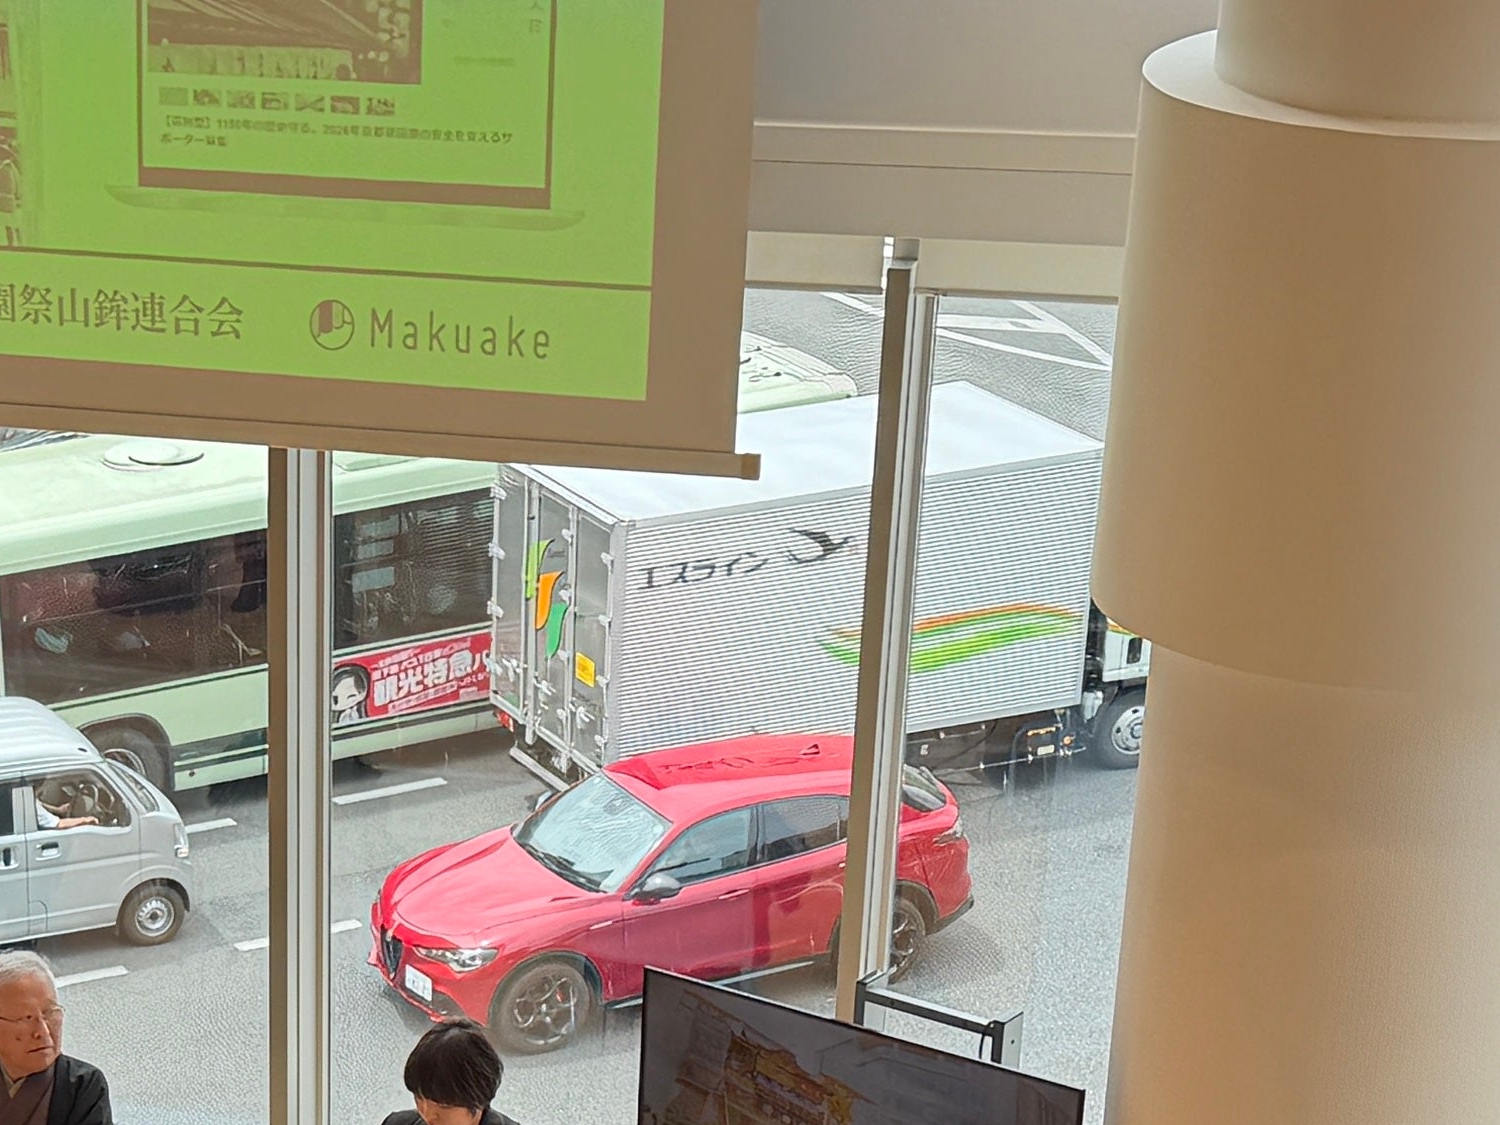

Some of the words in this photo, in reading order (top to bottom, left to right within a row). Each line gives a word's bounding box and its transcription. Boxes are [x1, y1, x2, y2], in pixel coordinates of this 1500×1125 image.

[369, 309, 552, 361] Makuake
[637, 551, 770, 590] エスライン
